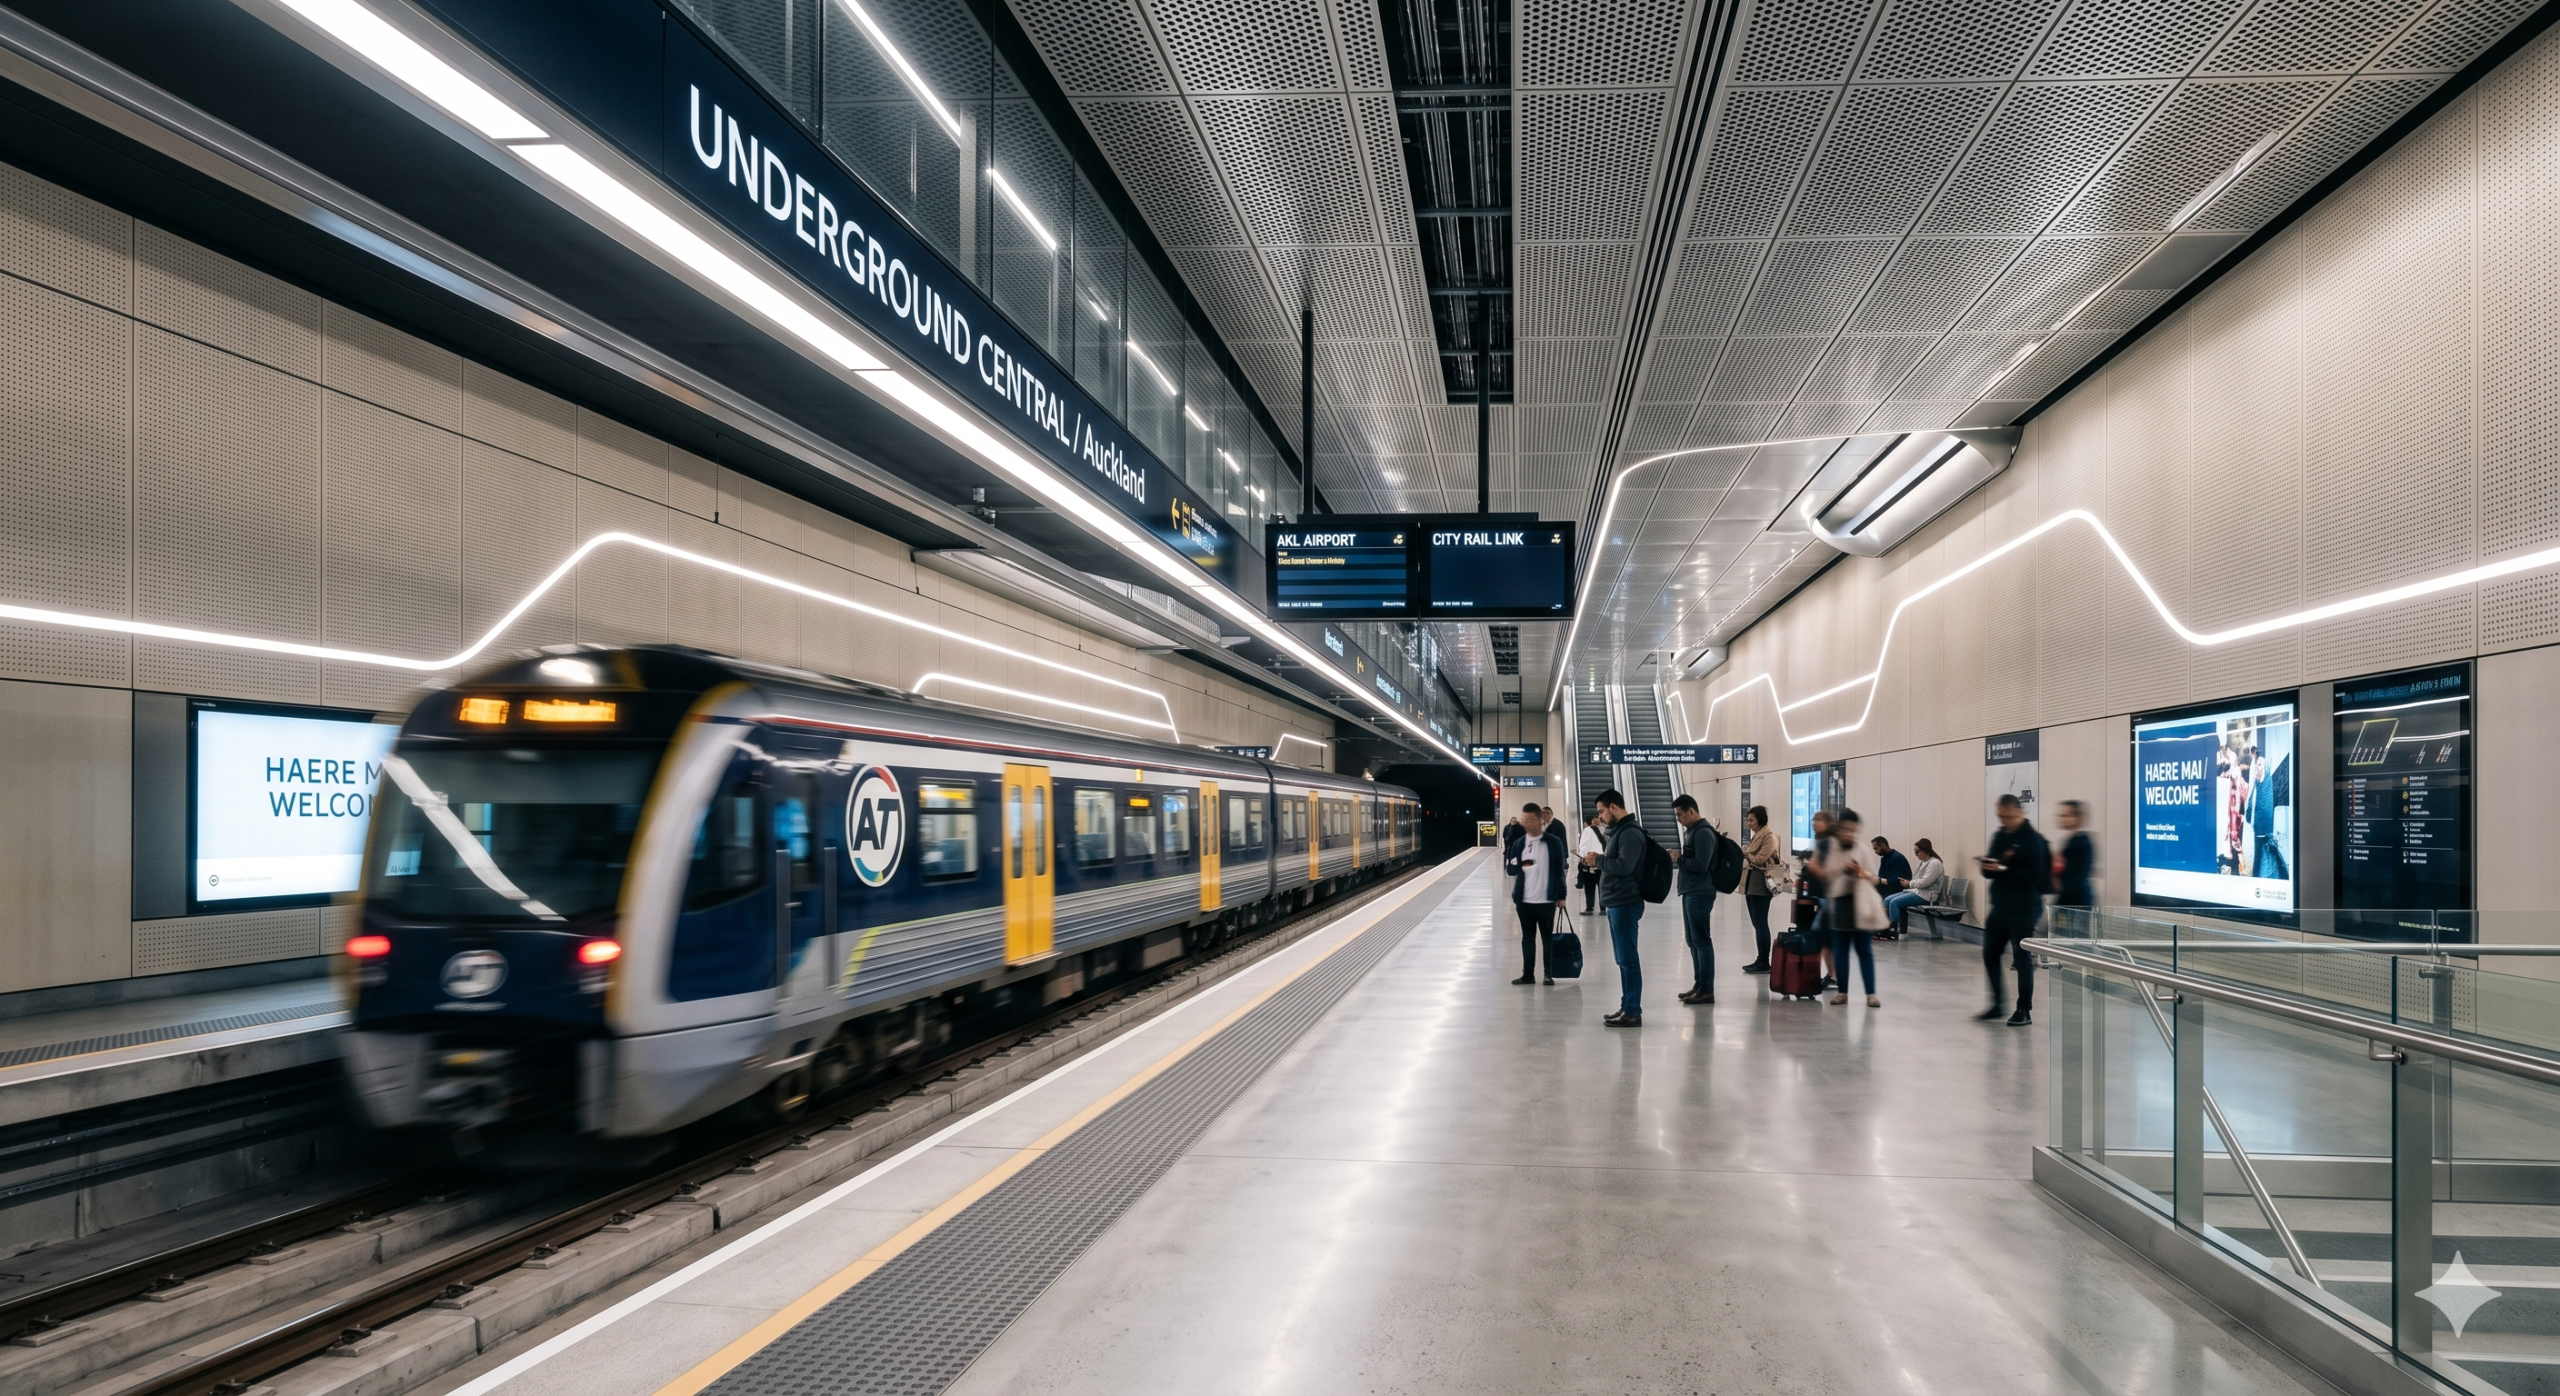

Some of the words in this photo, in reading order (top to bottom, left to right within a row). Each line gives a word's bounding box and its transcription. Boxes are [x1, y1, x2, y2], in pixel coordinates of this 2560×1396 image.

[690, 83, 971, 365] UNDERGROUND
[977, 334, 1071, 447] CENTRAL
[1073, 412, 1082, 454] /
[1083, 423, 1145, 505] Auckland
[1277, 534, 1301, 547] AKL
[1303, 533, 1357, 547] AIRPORT
[1432, 532, 1462, 546] CITY
[1463, 532, 1493, 546] RAIL
[1495, 532, 1525, 546] LINK
[266, 756, 356, 784] HAERE
[2145, 761, 2179, 782] HAERE
[2181, 759, 2203, 781] MAI
[268, 791, 376, 818] WELCO
[2144, 784, 2200, 806] WELCOME
[852, 798, 900, 850] AT
